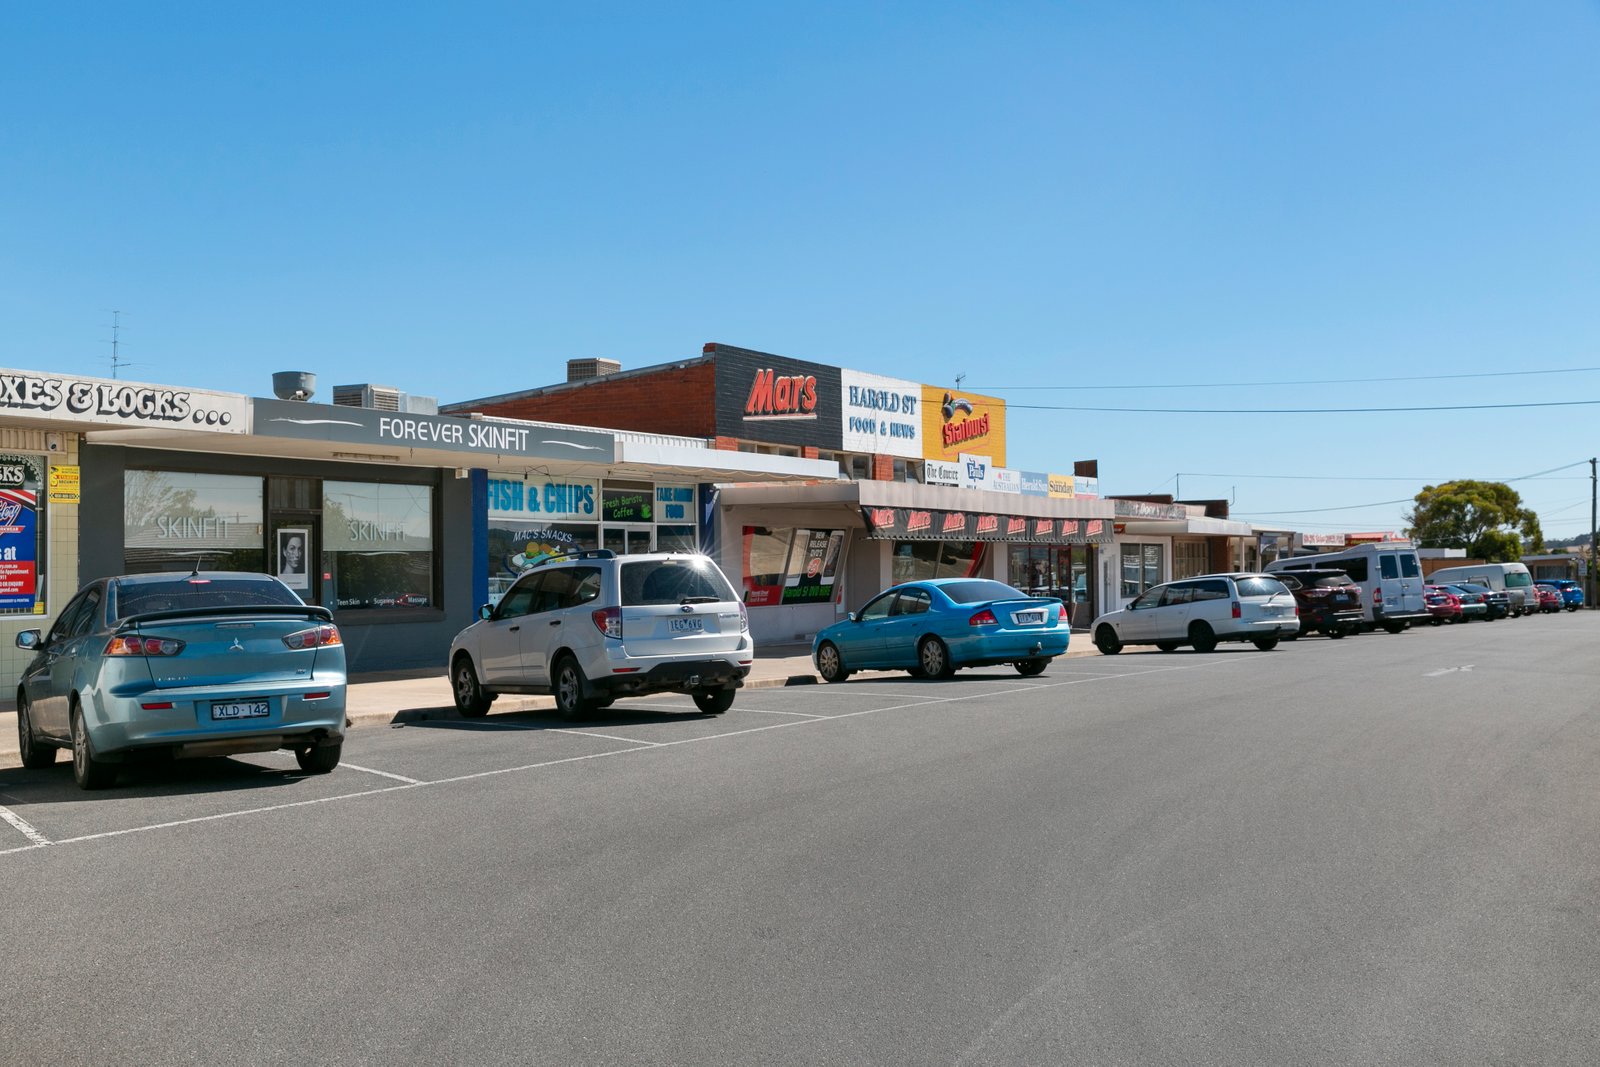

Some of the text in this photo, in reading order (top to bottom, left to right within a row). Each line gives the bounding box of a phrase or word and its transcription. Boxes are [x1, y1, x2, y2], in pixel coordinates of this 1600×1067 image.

[0, 375, 63, 411] XES
[66, 382, 94, 414] &
[744, 367, 818, 415] Mars
[849, 386, 917, 415] HAROLD ST
[379, 417, 530, 451] FOREVER SKINFIT
[849, 416, 916, 440] FOOD & NEWS
[942, 411, 991, 449] Starburst
[488, 479, 595, 515] FISH & CHIPS
[656, 487, 673, 501] TAKE
[1049, 480, 1074, 498] Sunday
[602, 495, 643, 509] Fresh Barista
[613, 508, 634, 518] Coffee
[907, 510, 931, 529] Mars
[943, 512, 965, 530] Mars
[157, 517, 229, 539] SKINFIT
[349, 520, 408, 542] SKINFIT
[977, 514, 998, 531] Mars
[1007, 517, 1026, 532] Mars
[512, 529, 573, 543] MAC'S SNACKS
[809, 540, 828, 549] RELEASE
[4, 546, 17, 561] at
[373, 597, 395, 605] Sugaring
[408, 596, 427, 604] Massage
